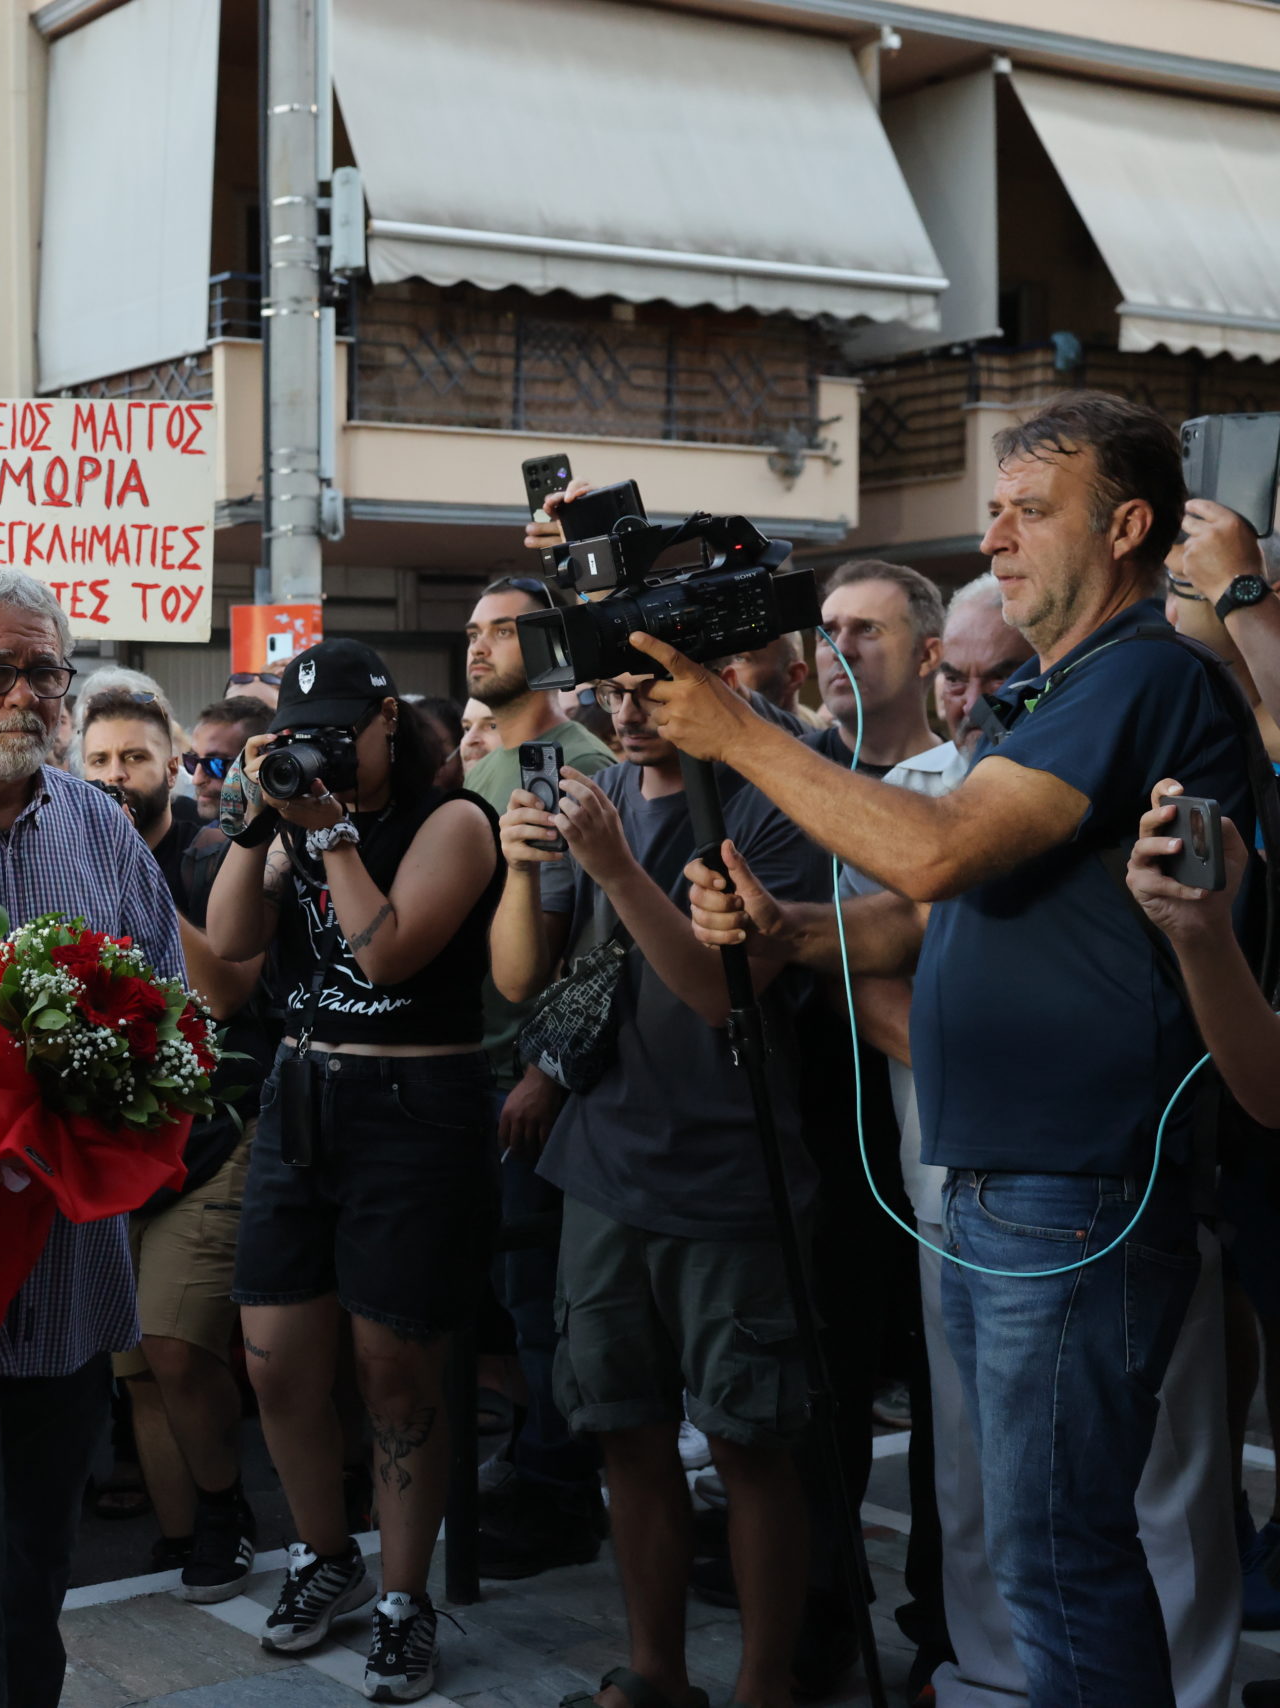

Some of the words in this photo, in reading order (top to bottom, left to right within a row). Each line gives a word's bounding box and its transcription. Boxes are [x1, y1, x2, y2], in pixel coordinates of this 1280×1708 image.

[70, 401, 214, 455] ΜΑΓΓΟΣ
[734, 571, 757, 581] SONY
[131, 582, 206, 625] ΤΟΥ
